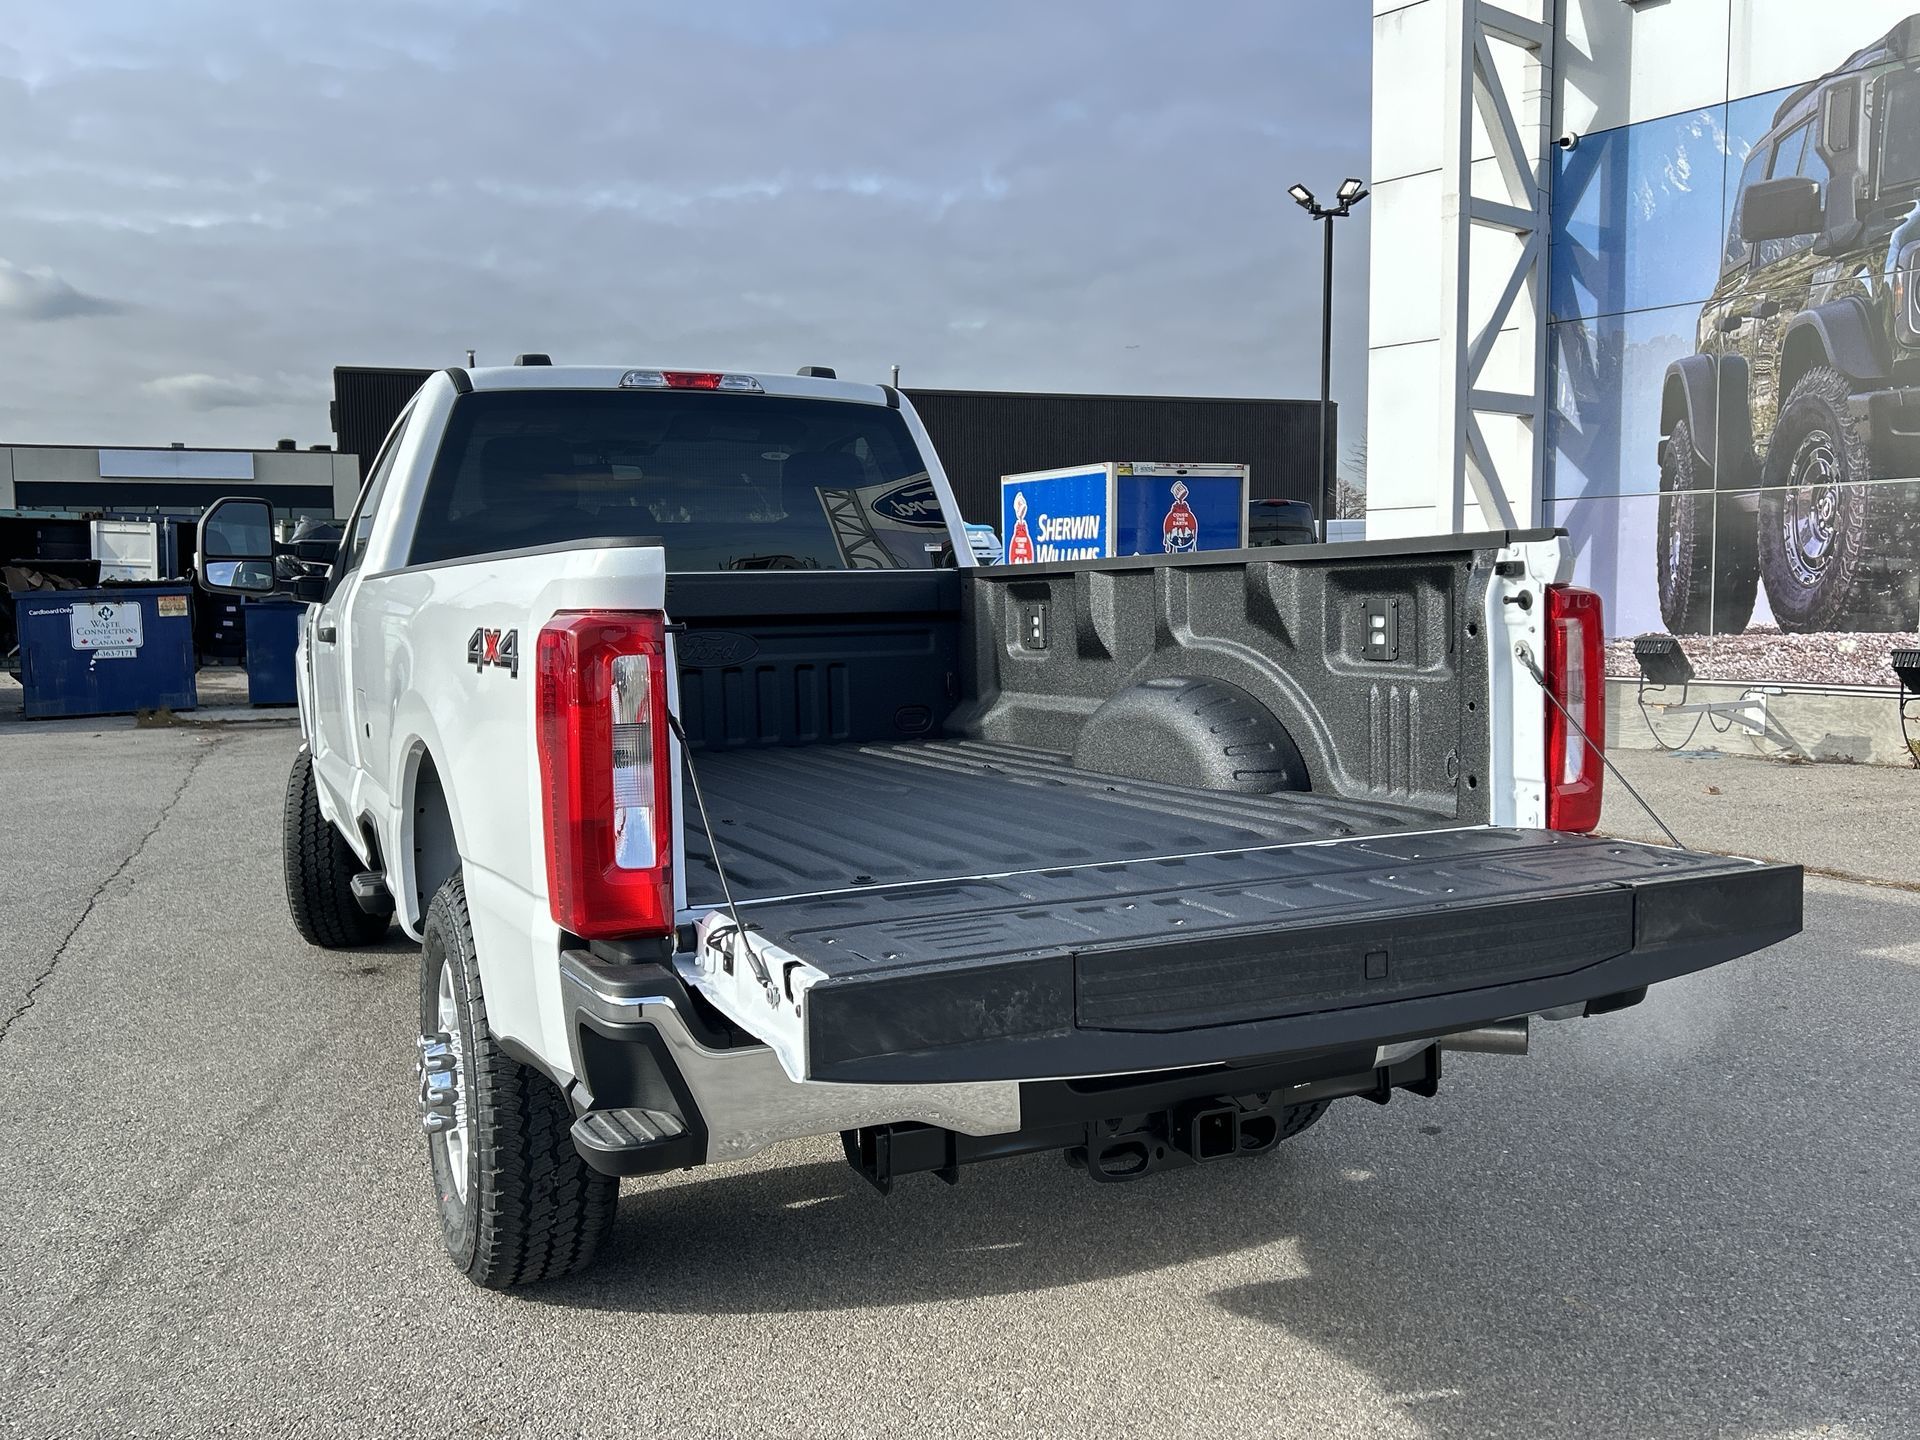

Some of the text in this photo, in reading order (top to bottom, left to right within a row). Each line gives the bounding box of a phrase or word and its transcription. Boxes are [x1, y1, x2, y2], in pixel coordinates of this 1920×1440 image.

[1037, 513, 1100, 542] SHERWIN
[28, 607, 73, 616] Cardboard Only
[90, 619, 120, 628] WASTE
[76, 627, 138, 636] CONNECTIONS
[91, 638, 125, 646] CANADA
